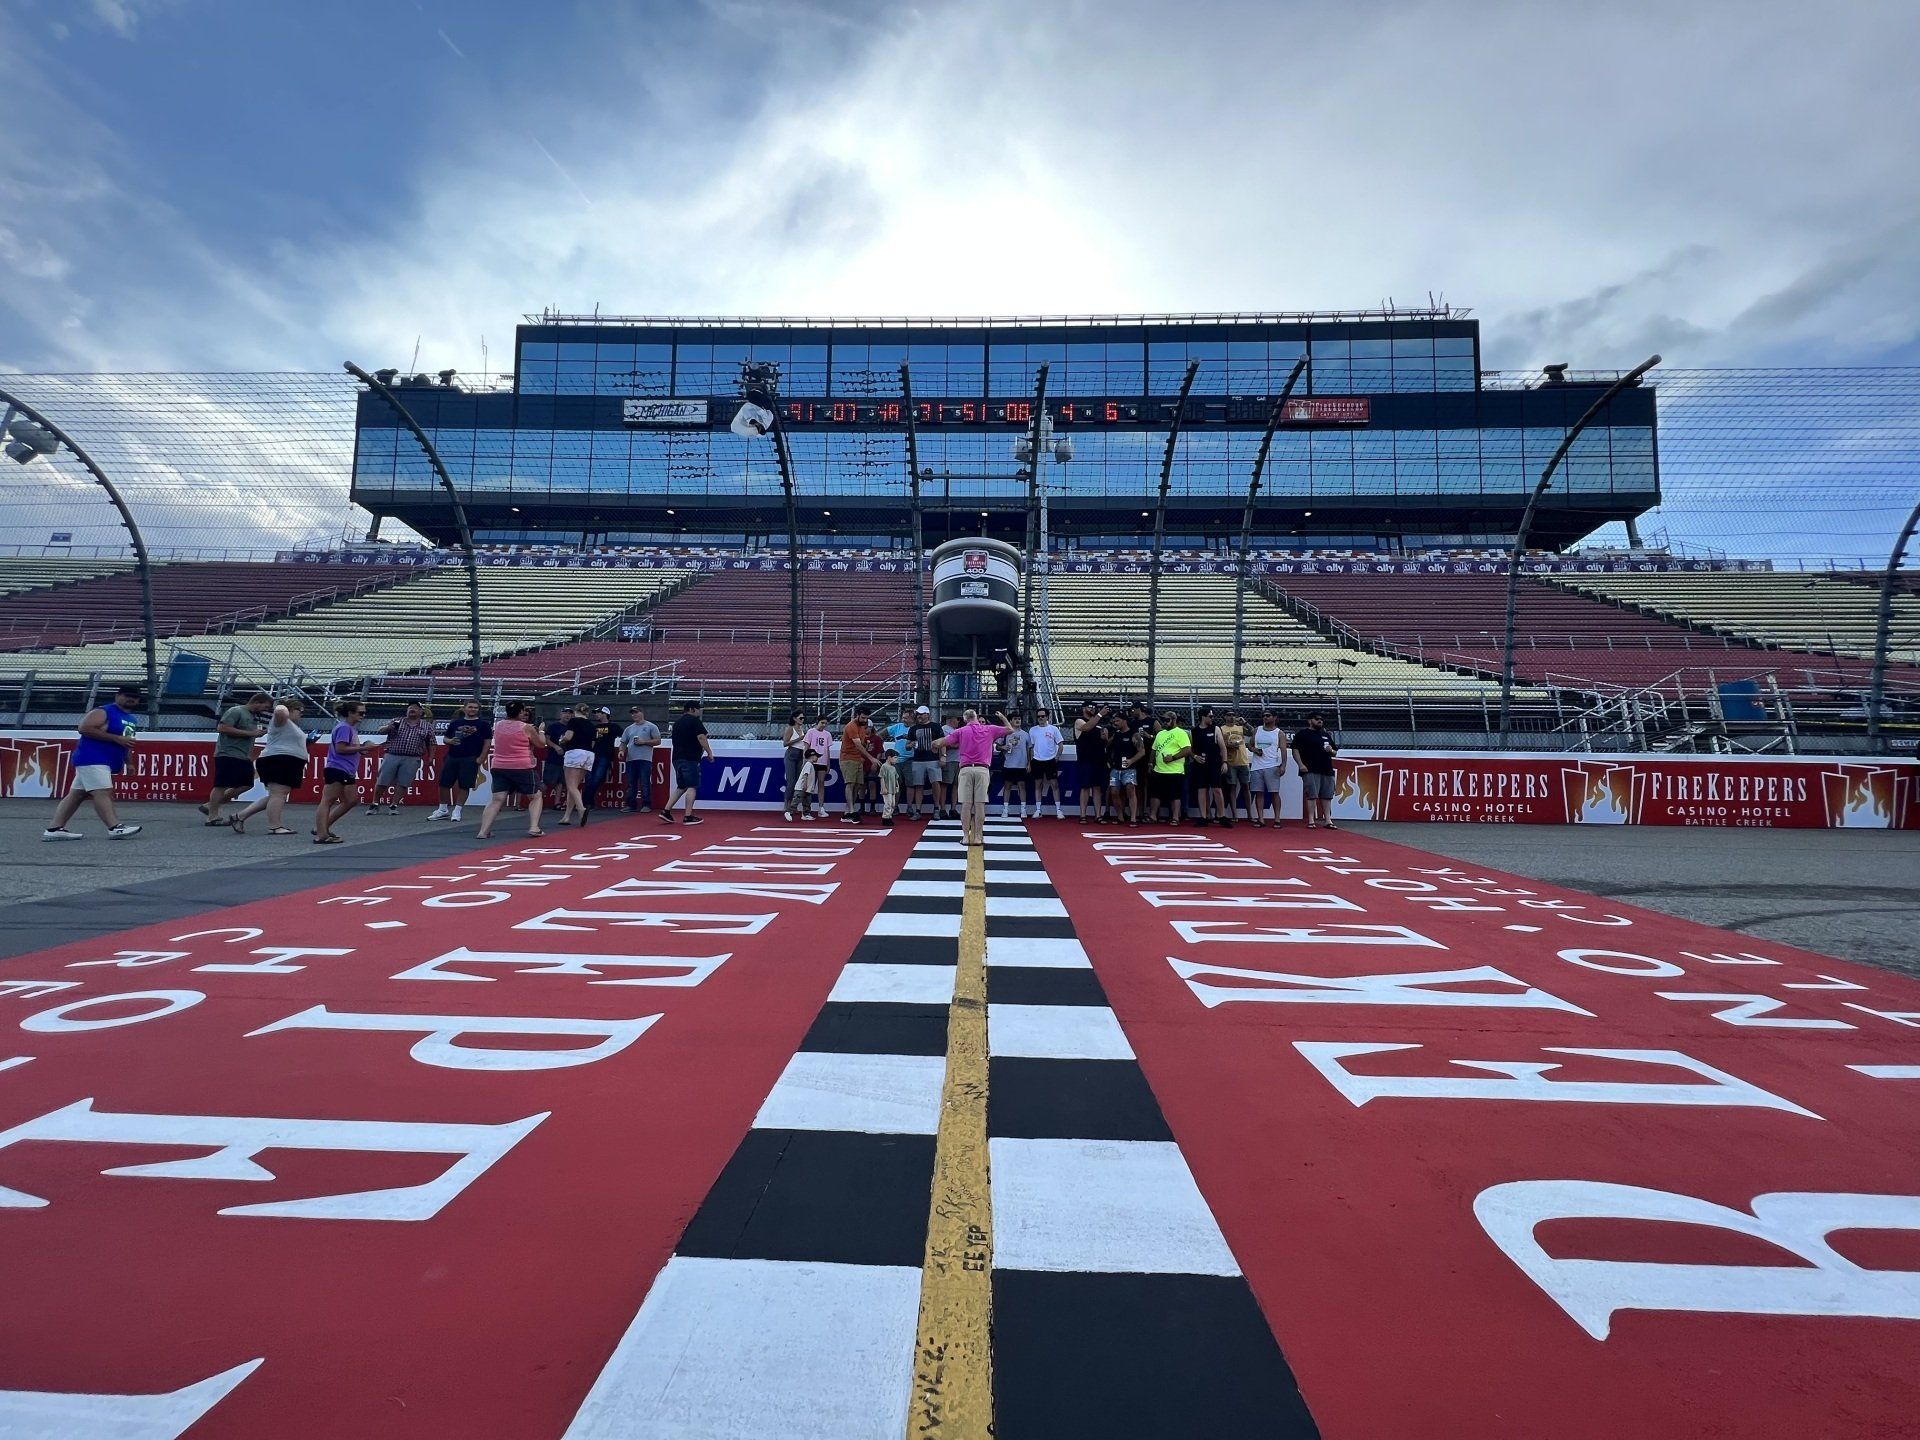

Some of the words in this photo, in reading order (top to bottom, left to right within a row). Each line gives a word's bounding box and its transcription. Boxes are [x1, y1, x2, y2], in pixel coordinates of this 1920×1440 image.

[791, 403, 813, 421] 91
[834, 403, 856, 421] 07
[920, 404, 943, 421] 31
[963, 403, 987, 421] 51
[1007, 403, 1030, 421] 08
[1062, 403, 1073, 421] 4
[1106, 402, 1118, 421] 6
[152, 782, 194, 791] HOTEL
[1398, 769, 1549, 798] FIREKEEPERS
[1651, 772, 1807, 802] FIREKEEPERS
[1412, 802, 1471, 812] CASINO
[1485, 803, 1533, 813] HOTEL
[1667, 806, 1727, 816] CASINO
[1741, 807, 1791, 817] HOTEL
[1430, 814, 1471, 822] BATTLE
[1479, 814, 1515, 823] CREEK
[1685, 818, 1727, 826] BATTLE
[1736, 819, 1772, 827] CREEK
[318, 848, 568, 906] BATTLE
[421, 834, 682, 907] CASINO
[1282, 847, 1506, 911] HOTEL
